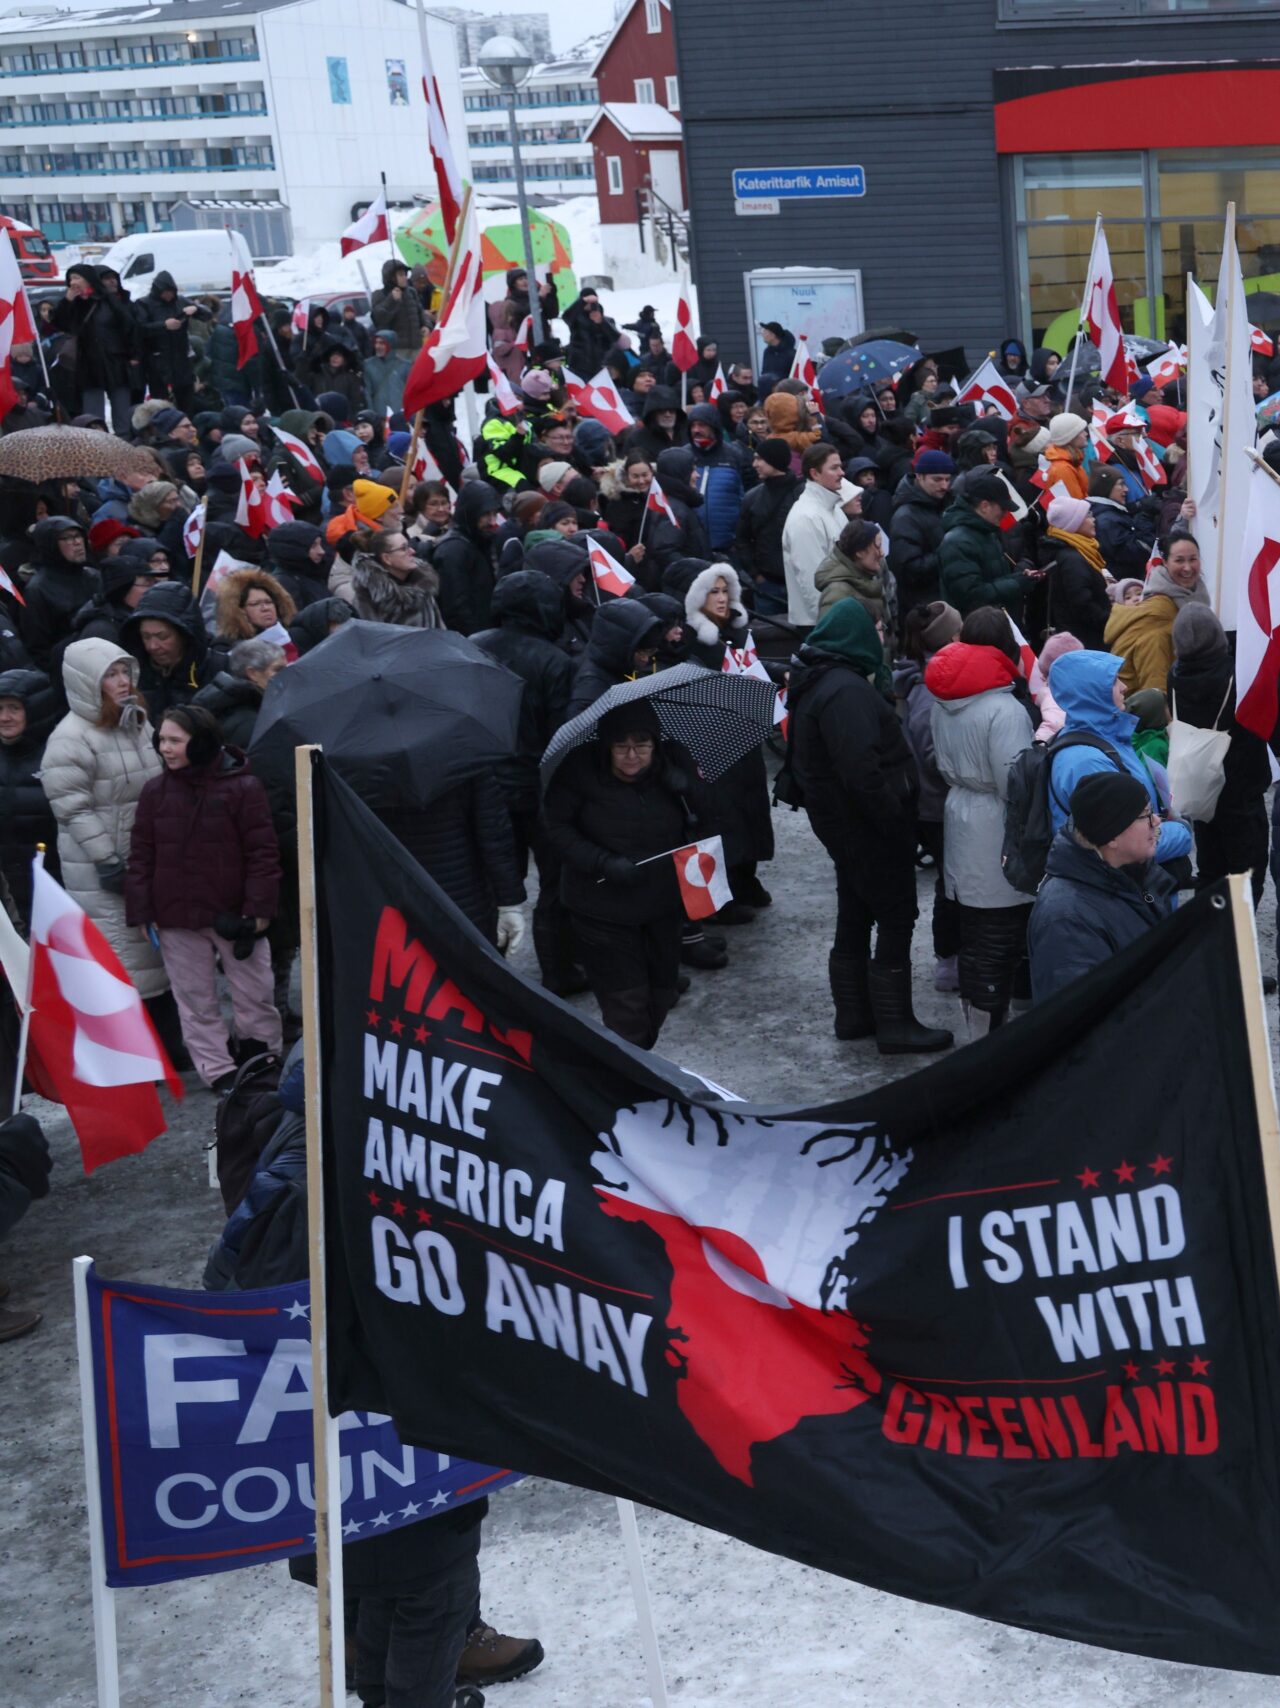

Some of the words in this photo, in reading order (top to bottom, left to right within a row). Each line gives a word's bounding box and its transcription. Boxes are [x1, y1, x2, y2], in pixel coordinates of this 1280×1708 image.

[738, 176, 811, 190] Katerittarfik
[816, 175, 860, 188] Amisut
[791, 286, 816, 297] Nuuk
[363, 1032, 503, 1140] MAKE
[362, 1116, 566, 1252] AMERICA
[948, 1215, 969, 1289] I
[979, 1183, 1186, 1284] STAND
[371, 1215, 466, 1316] GO
[485, 1251, 654, 1398] AWAY
[1034, 1275, 1206, 1363] WITH
[143, 1333, 393, 1449] FA
[881, 1381, 1219, 1460] GREENLAND
